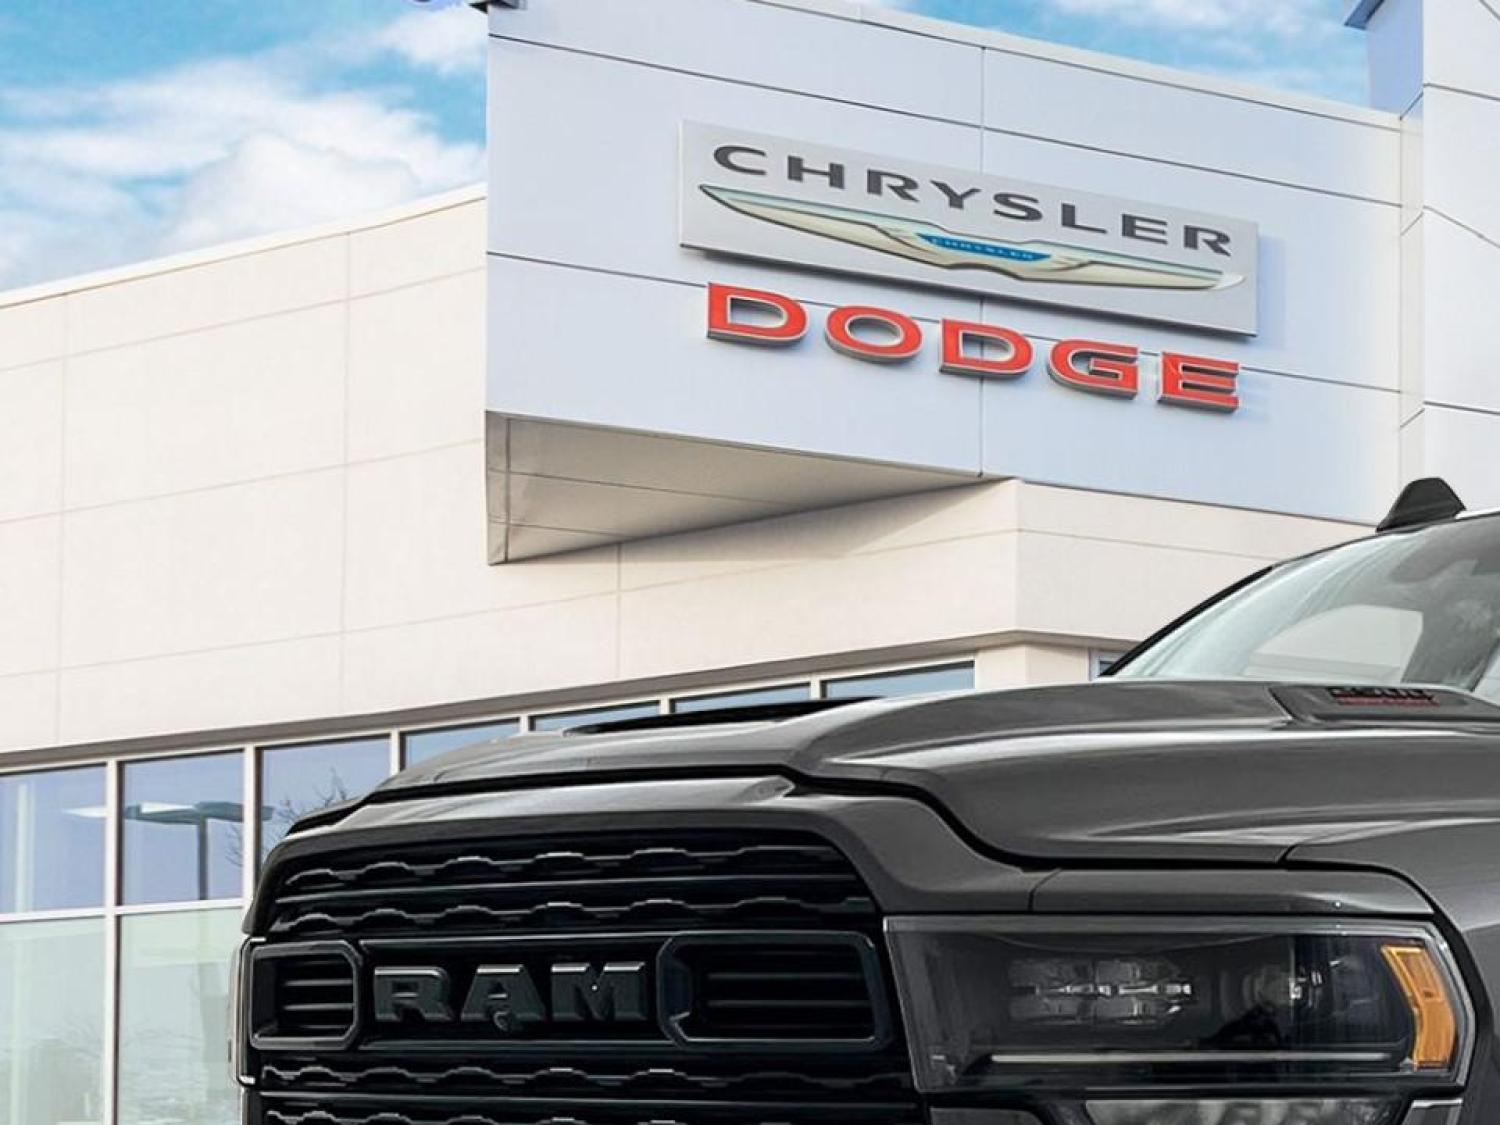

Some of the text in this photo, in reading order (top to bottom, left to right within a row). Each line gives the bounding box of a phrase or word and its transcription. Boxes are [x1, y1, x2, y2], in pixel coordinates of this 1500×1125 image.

[713, 145, 1232, 257] CHRYSLER
[706, 282, 1240, 414] DODGE
[374, 960, 648, 1023] RAM
